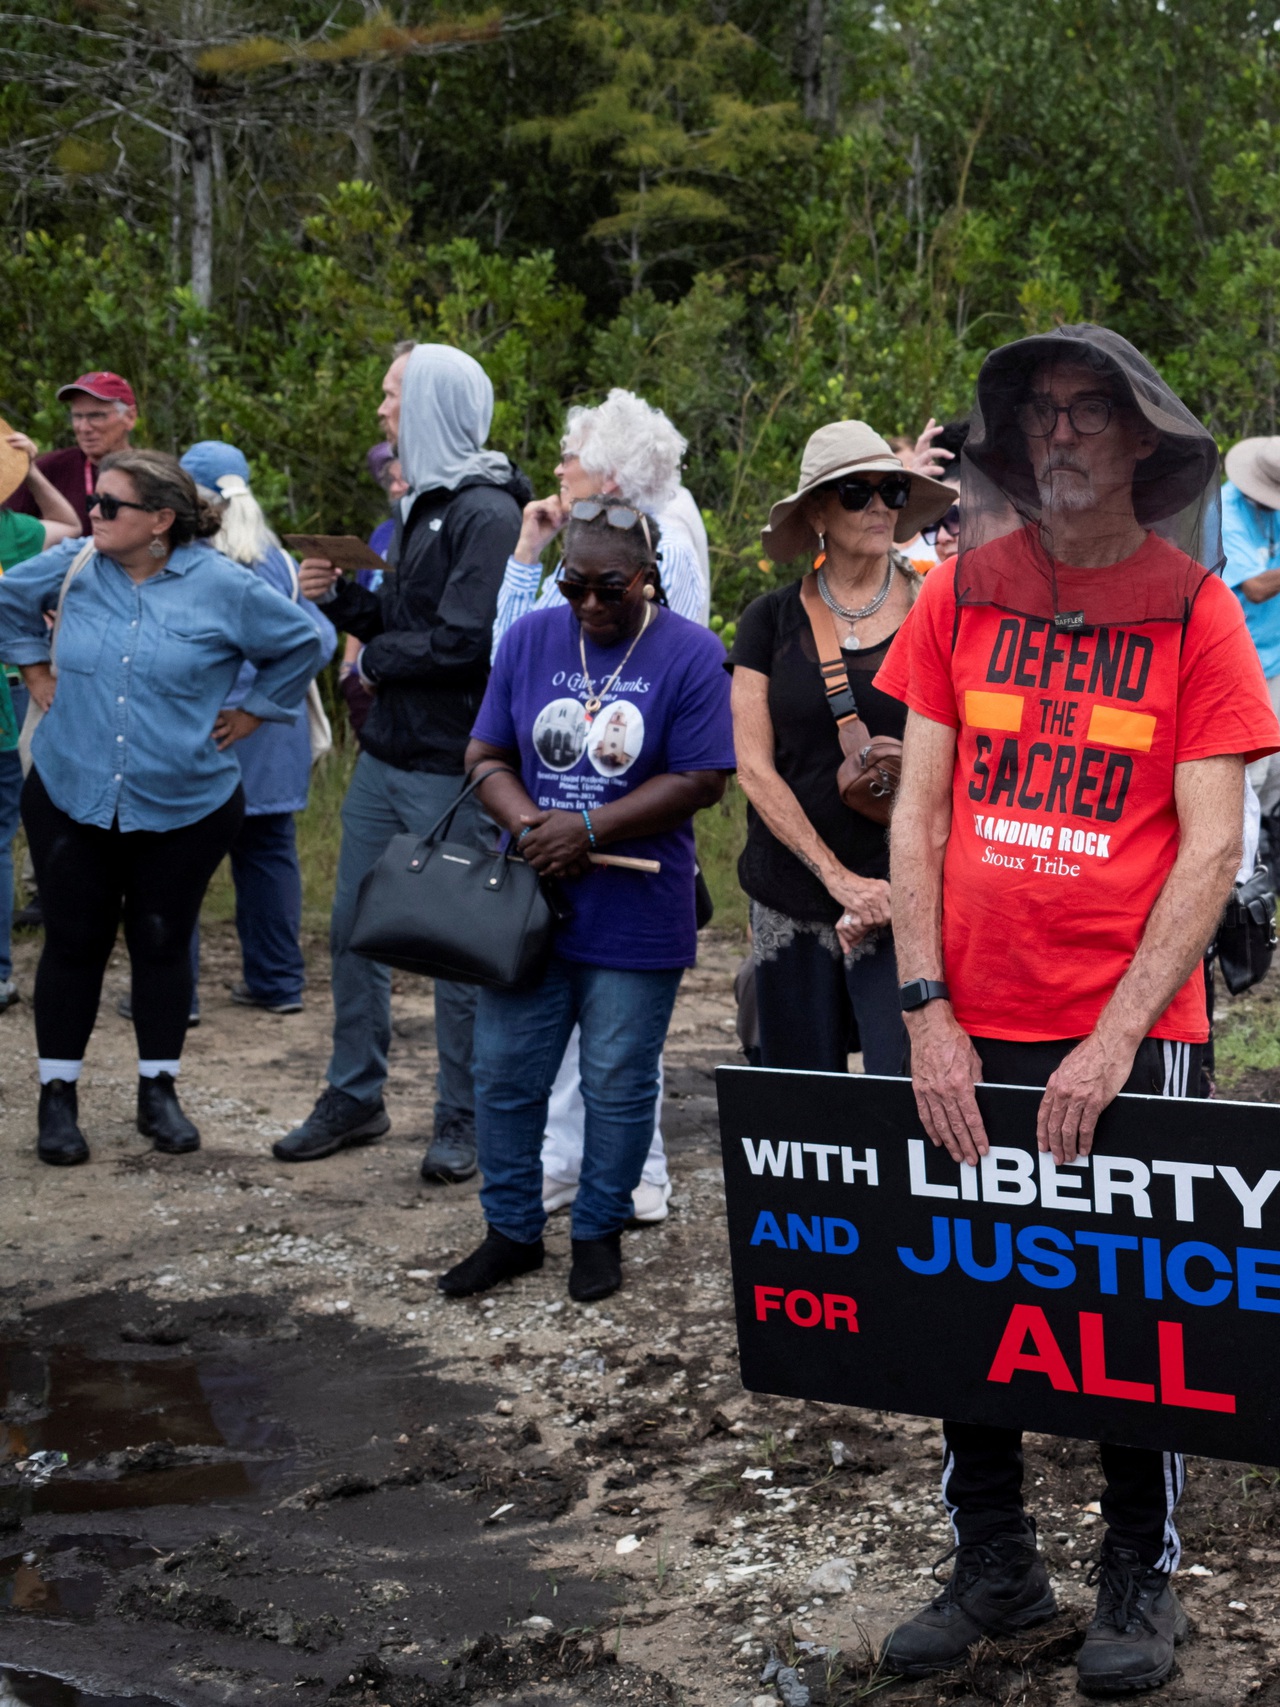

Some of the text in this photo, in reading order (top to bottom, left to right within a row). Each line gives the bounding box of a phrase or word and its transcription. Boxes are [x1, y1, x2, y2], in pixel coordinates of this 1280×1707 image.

[1054, 615, 1084, 626] BAFFLER
[551, 671, 566, 687] O
[985, 618, 1154, 703] DEFEND
[1039, 699, 1078, 738] THE
[967, 734, 1134, 823] SACRED
[551, 797, 574, 809] Years
[575, 799, 586, 810] in
[981, 845, 1082, 878] Sioux Tribe
[1057, 827, 1111, 858] ROCK
[741, 1137, 879, 1186] WITH
[750, 1210, 860, 1255] AND
[754, 1285, 1236, 1414] FOR ALL
